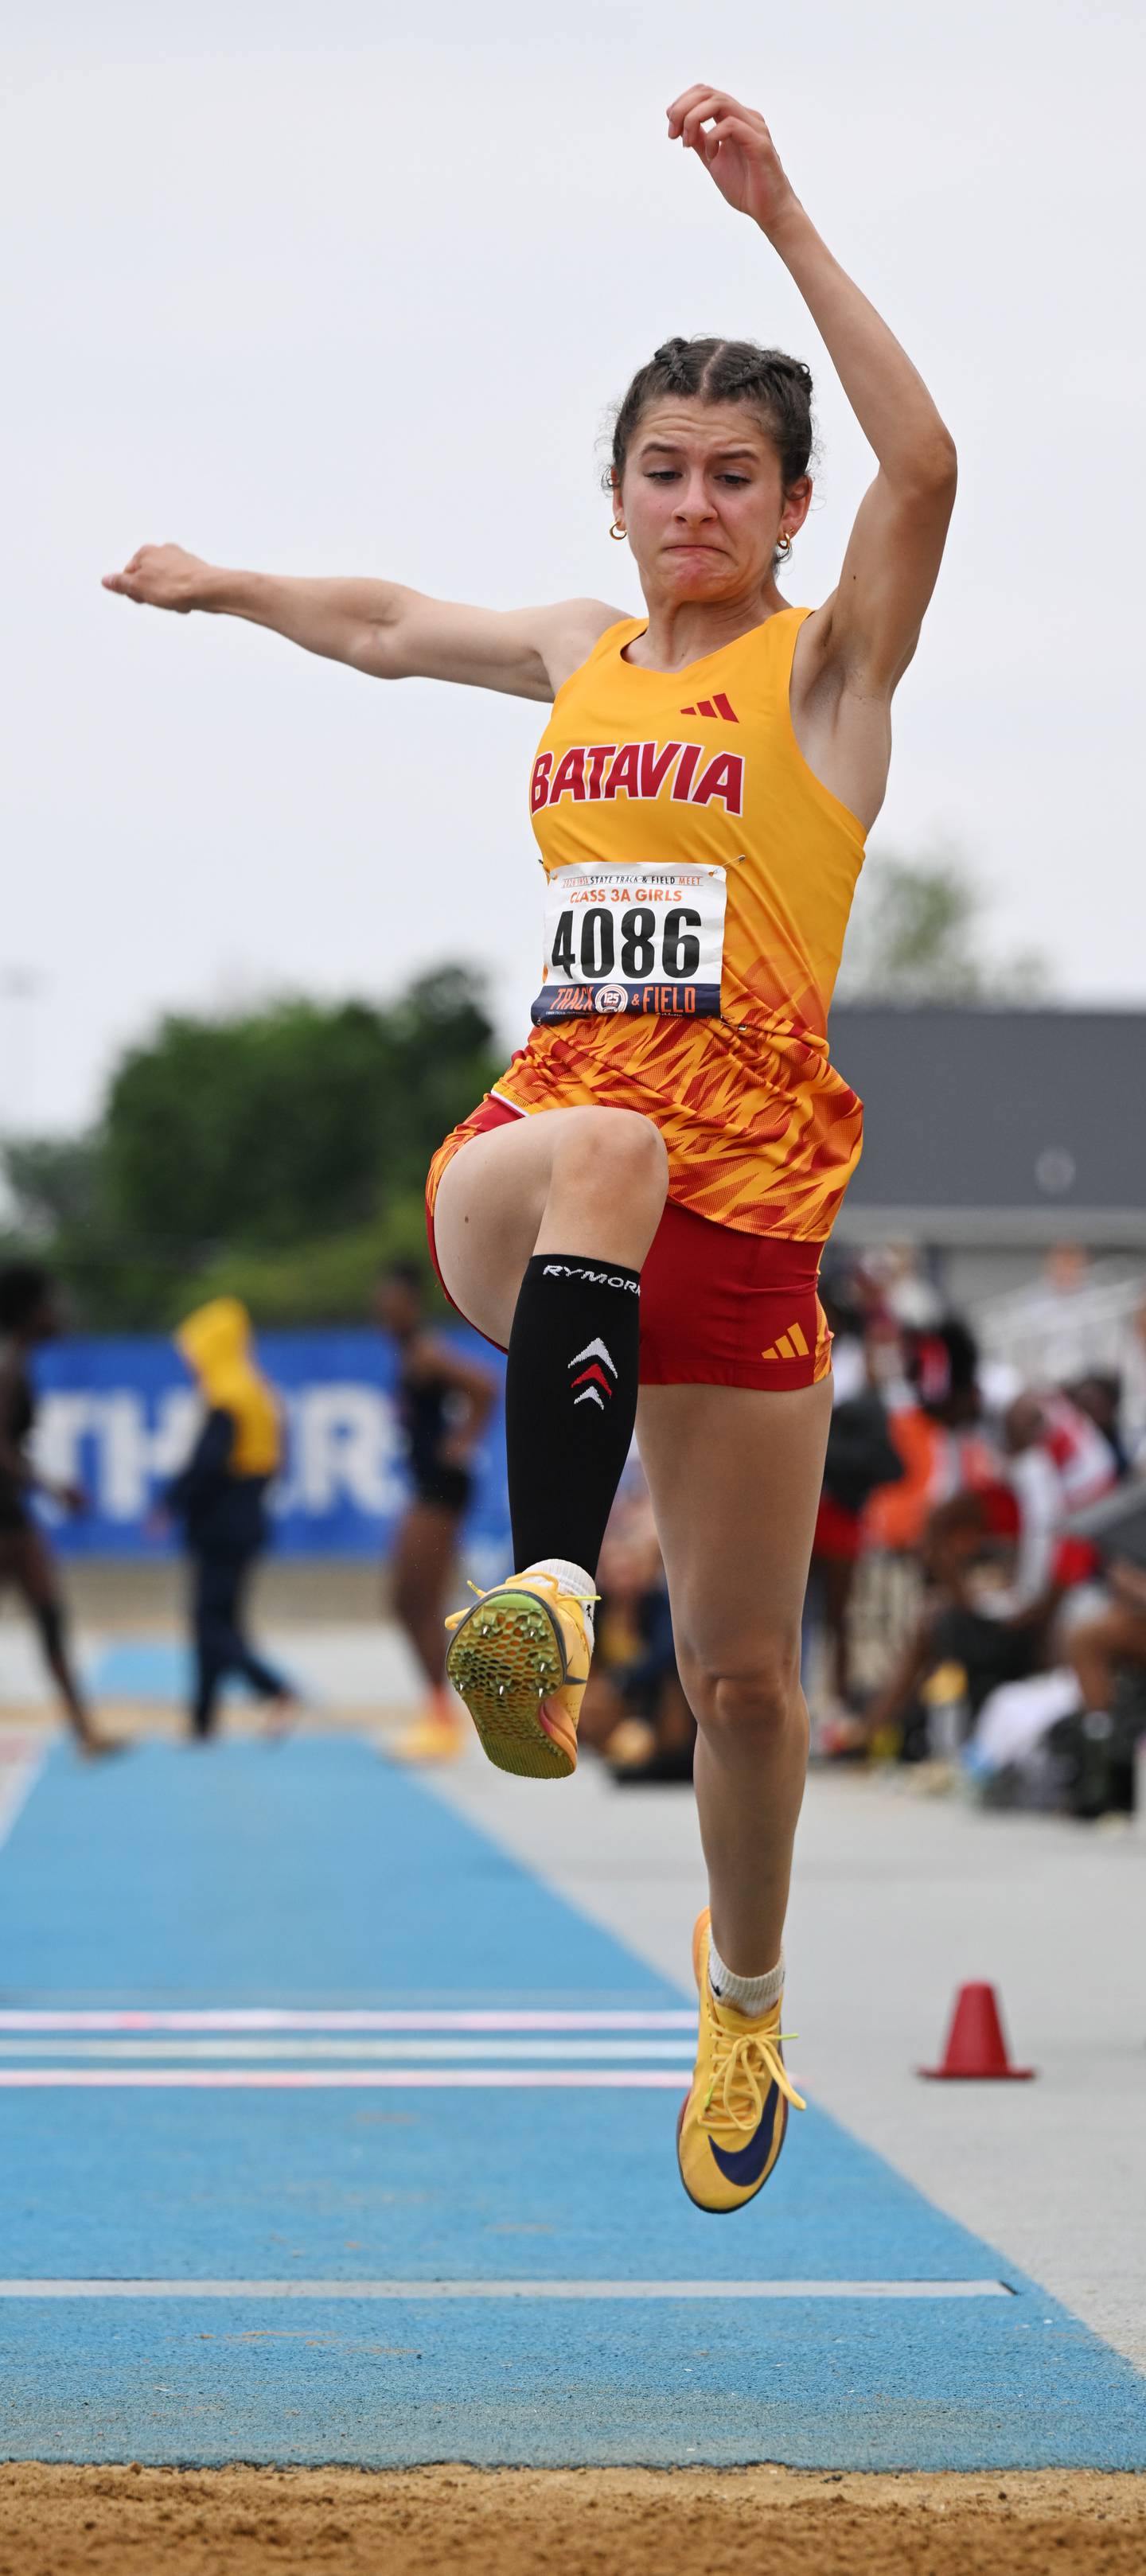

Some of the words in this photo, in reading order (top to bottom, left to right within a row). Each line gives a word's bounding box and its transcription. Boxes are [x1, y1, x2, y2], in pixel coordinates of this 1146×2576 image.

[531, 740, 746, 818] BATAVIA
[570, 889, 606, 904] CLASS
[610, 889, 631, 902] 3A
[635, 889, 683, 902] GIRLS
[552, 907, 702, 980] 4086
[549, 986, 594, 1011] TRACK
[631, 993, 640, 1006] &
[642, 986, 696, 1013] FIELD
[603, 992, 619, 1004] 125
